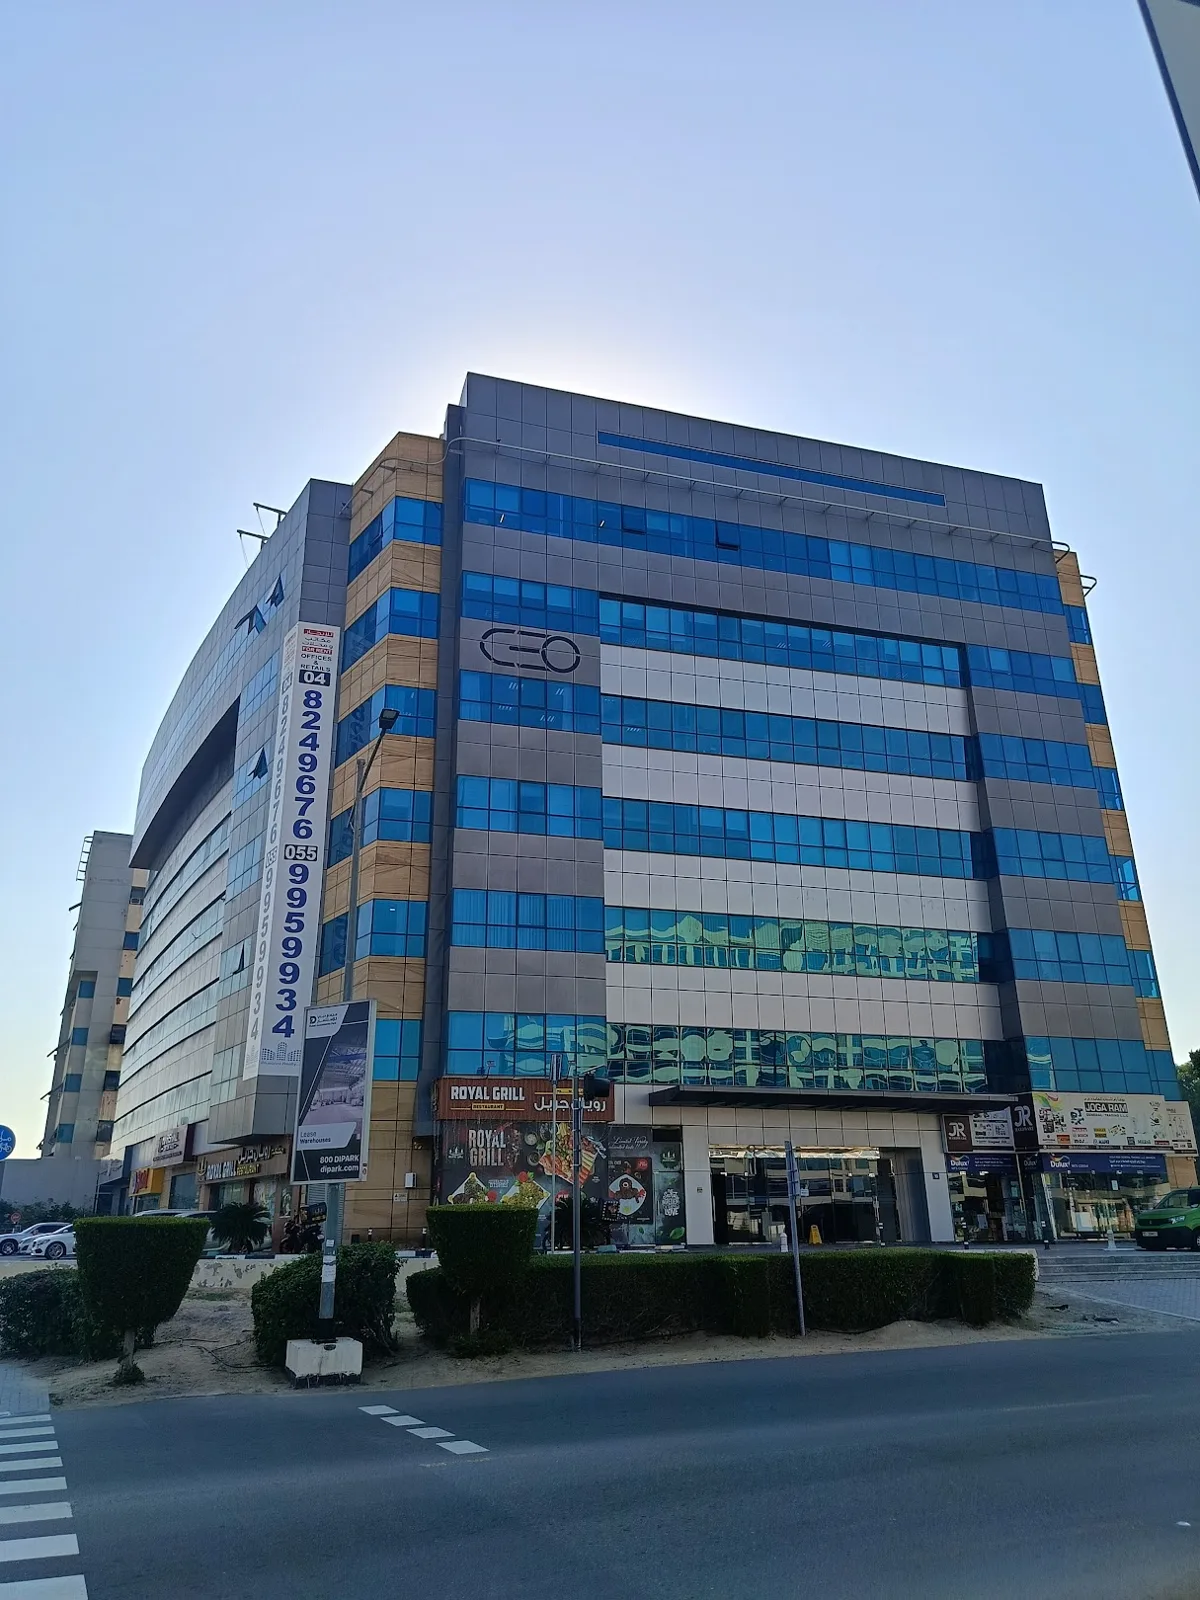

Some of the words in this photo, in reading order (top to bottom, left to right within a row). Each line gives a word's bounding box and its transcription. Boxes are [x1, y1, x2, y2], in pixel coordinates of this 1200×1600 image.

[301, 664, 331, 672] RETAILS
[303, 671, 326, 685] 04
[285, 845, 317, 860] 055
[451, 1086, 490, 1100] ROYAL
[492, 1087, 525, 1101] GRILL
[1086, 1103, 1107, 1112] JOGA
[1108, 1103, 1127, 1113] RAM
[1014, 1105, 1033, 1127] JR
[948, 1122, 966, 1137] JR
[300, 1136, 331, 1144] Warehouses
[468, 1129, 506, 1148] ROYAL
[320, 1156, 333, 1164] 800
[334, 1154, 360, 1163] DIPARK
[469, 1148, 505, 1167] GRILL
[1050, 1160, 1068, 1168] Dulux
[206, 1162, 222, 1180] ROYAL
[222, 1159, 237, 1178] GRILL
[236, 1163, 260, 1176] RESTAURANT
[320, 1164, 359, 1174] dipark.com
